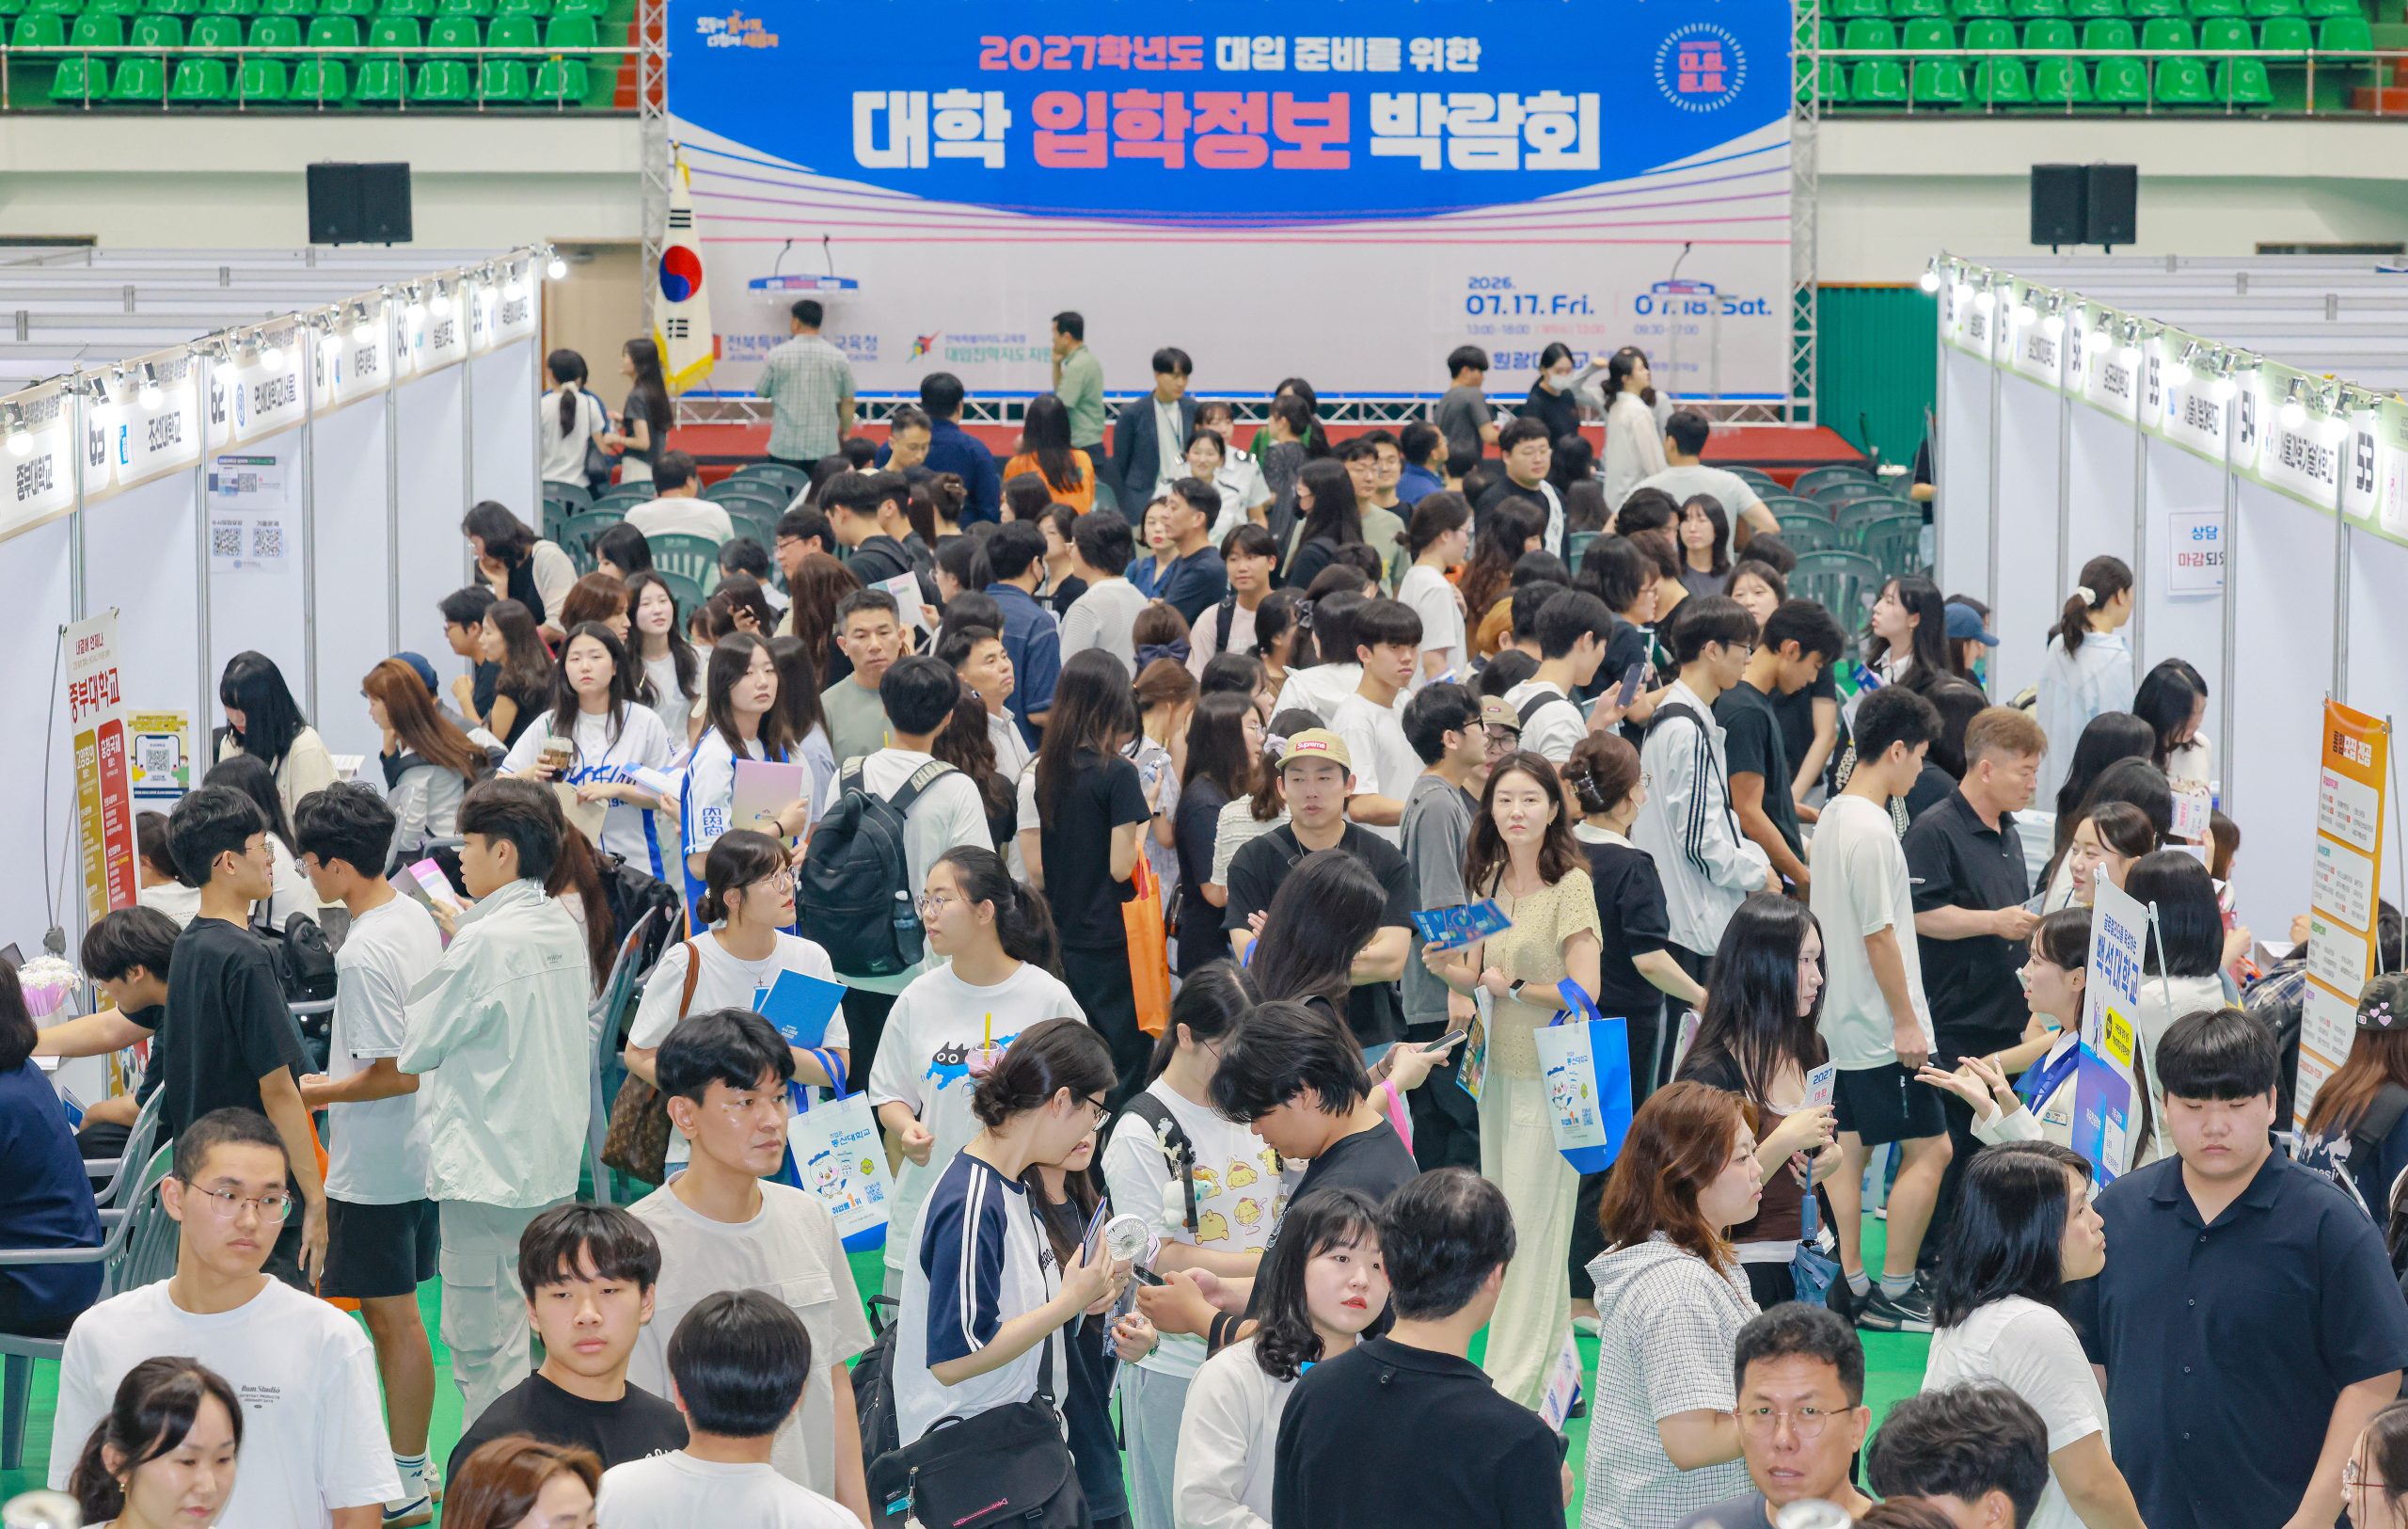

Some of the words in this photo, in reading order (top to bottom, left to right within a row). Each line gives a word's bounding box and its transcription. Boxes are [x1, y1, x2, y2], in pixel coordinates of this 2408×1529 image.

[979, 35, 1204, 71] 2027학년도
[1215, 36, 1286, 71] 대입
[1294, 36, 1401, 72] 준비를
[1409, 36, 1481, 72] 위한
[852, 88, 1012, 168] 대학
[1031, 88, 1351, 169] 입학정보
[1370, 90, 1600, 170] 박람회
[1467, 276, 1515, 290] 2026.
[1493, 350, 1588, 371] 원광교
[148, 410, 182, 453] 조선대학교
[2241, 389, 2256, 447] 54
[16, 454, 54, 502] 중부대학교
[2356, 431, 2375, 494] 53
[2192, 525, 2218, 541] 상담
[69, 666, 120, 724] 중부대학교
[1297, 741, 1326, 750] Supreme
[2096, 932, 2139, 1007] 백석대학교
[1813, 1067, 1833, 1085] 2027
[831, 1128, 871, 1148] 동신대학교
